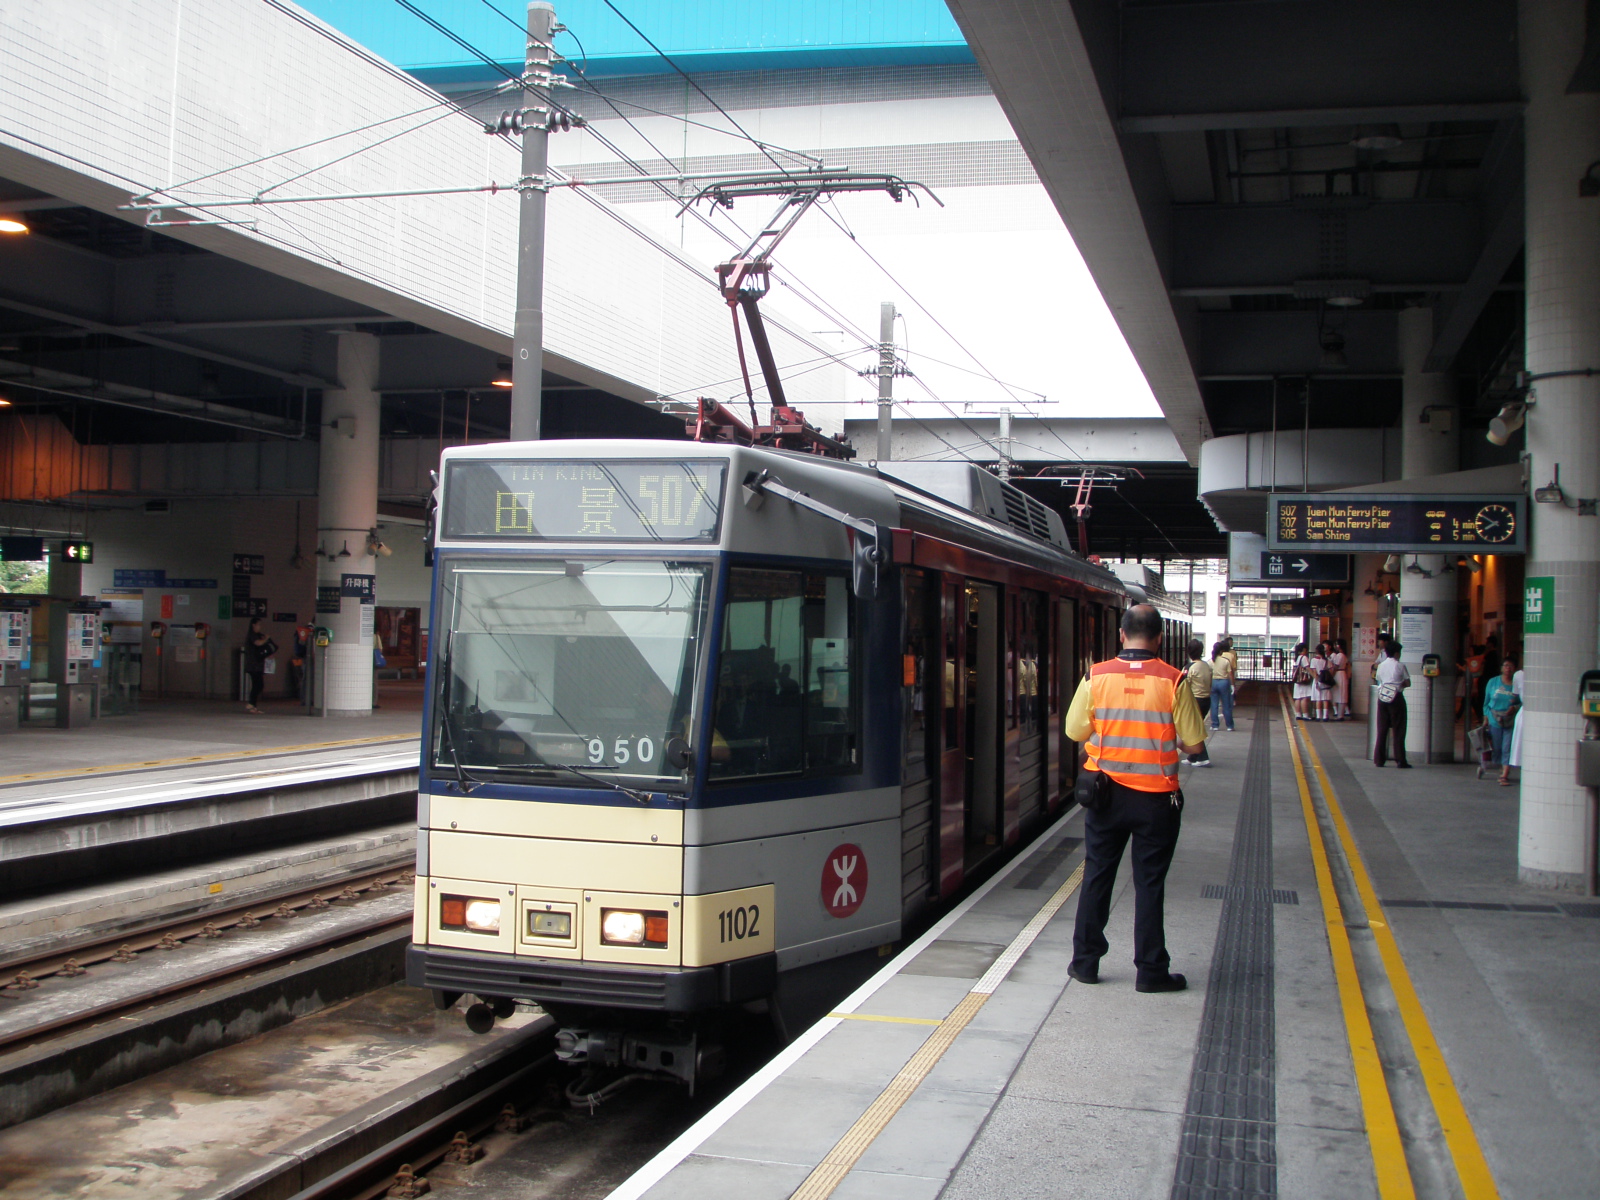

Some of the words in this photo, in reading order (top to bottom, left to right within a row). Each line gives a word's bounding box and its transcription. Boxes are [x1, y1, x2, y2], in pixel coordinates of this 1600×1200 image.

[511, 466, 544, 480] TIN
[556, 466, 604, 480] KING
[639, 475, 707, 526] 507
[1280, 505, 1297, 517] 507
[1306, 505, 1327, 517] Tuen
[1328, 505, 1346, 517] Mun
[1347, 505, 1371, 518] Ferry
[1371, 505, 1391, 517] Pier
[1280, 517, 1297, 528] 507
[1306, 517, 1327, 528] Tuen
[1328, 517, 1346, 528] Mun
[1347, 517, 1371, 529] Ferry
[1371, 517, 1391, 528] Pier
[1452, 518, 1459, 529] 4
[1462, 519, 1476, 530] min
[1280, 528, 1297, 539] 505
[1306, 528, 1324, 539] Sam
[1325, 528, 1351, 540] Shing
[1452, 529, 1459, 541] 5
[1462, 530, 1476, 541] min
[345, 577, 369, 588] 升降機
[1525, 587, 1542, 613] 出
[1525, 613, 1542, 623] EXIT
[588, 737, 654, 764] 950
[718, 904, 760, 943] 1102
